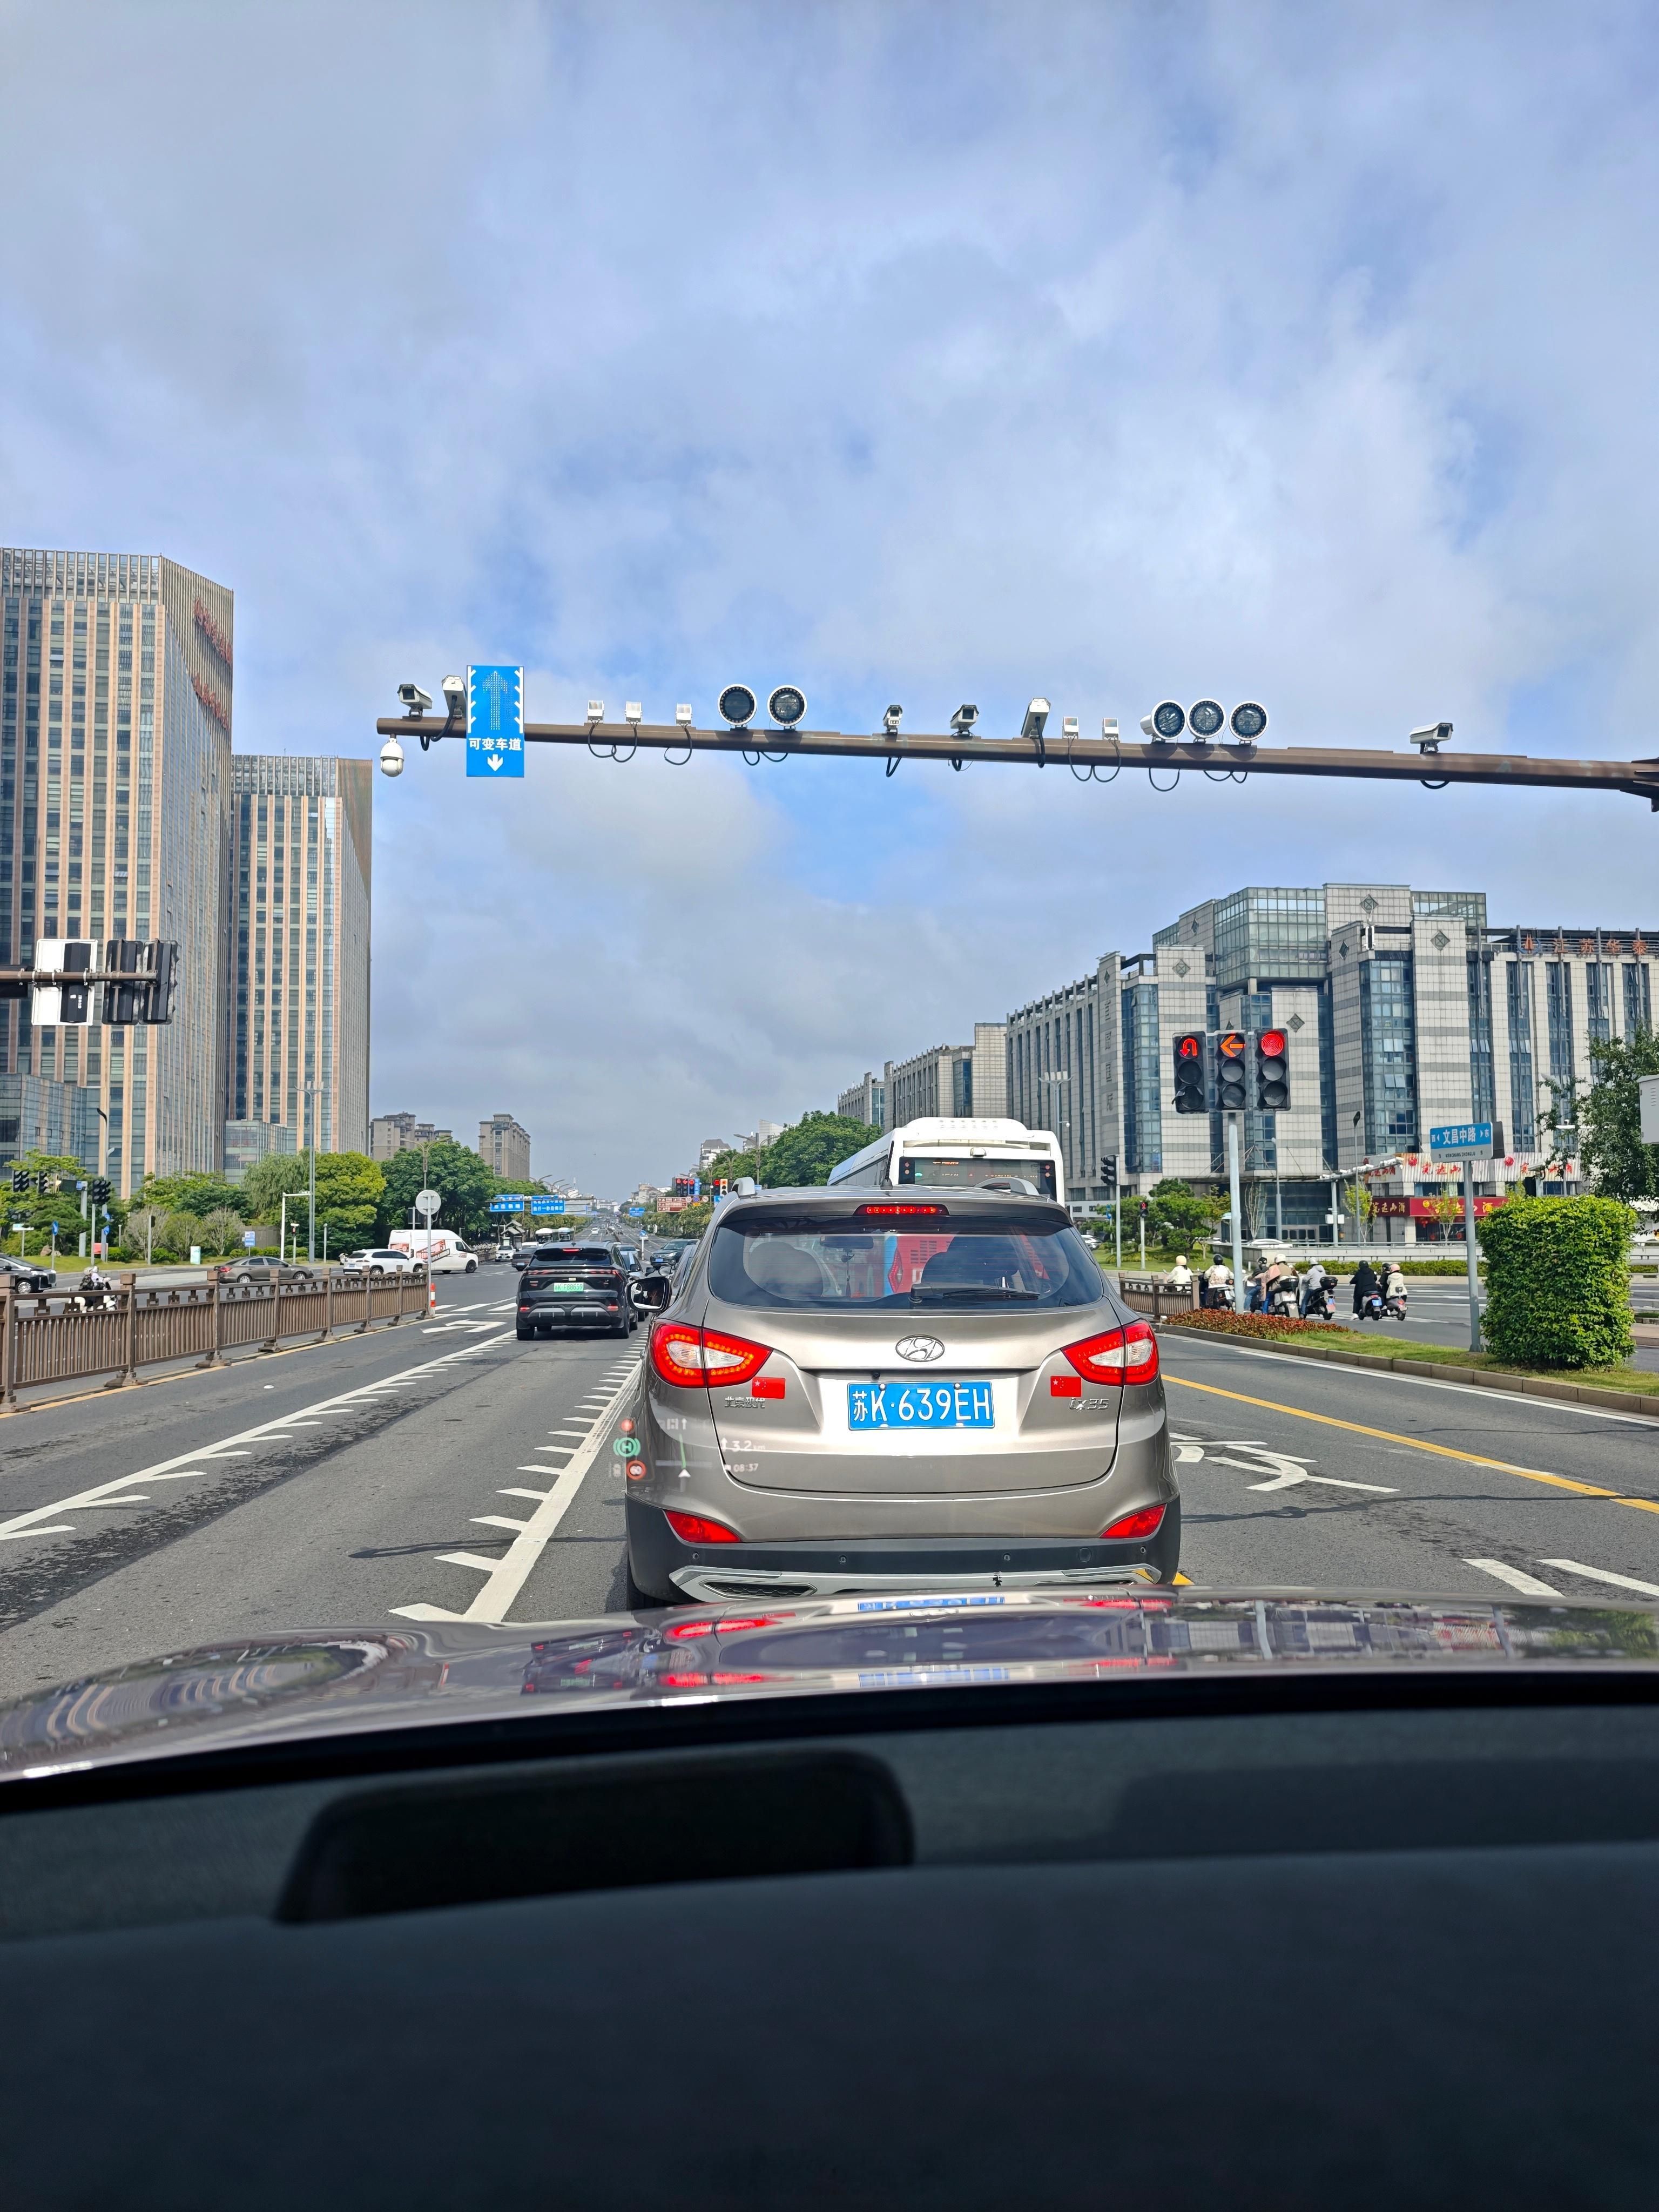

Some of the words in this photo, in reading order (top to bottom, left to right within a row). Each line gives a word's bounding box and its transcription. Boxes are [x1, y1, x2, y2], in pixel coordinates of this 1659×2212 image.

[468, 737, 522, 751] 可变车道
[1553, 938, 1647, 955] 江苏华泰
[1442, 1127, 1476, 1145] 文昌中路
[1485, 1129, 1489, 1138] 东
[725, 1396, 765, 1408] 北京现代
[1069, 1398, 1110, 1410] ix35
